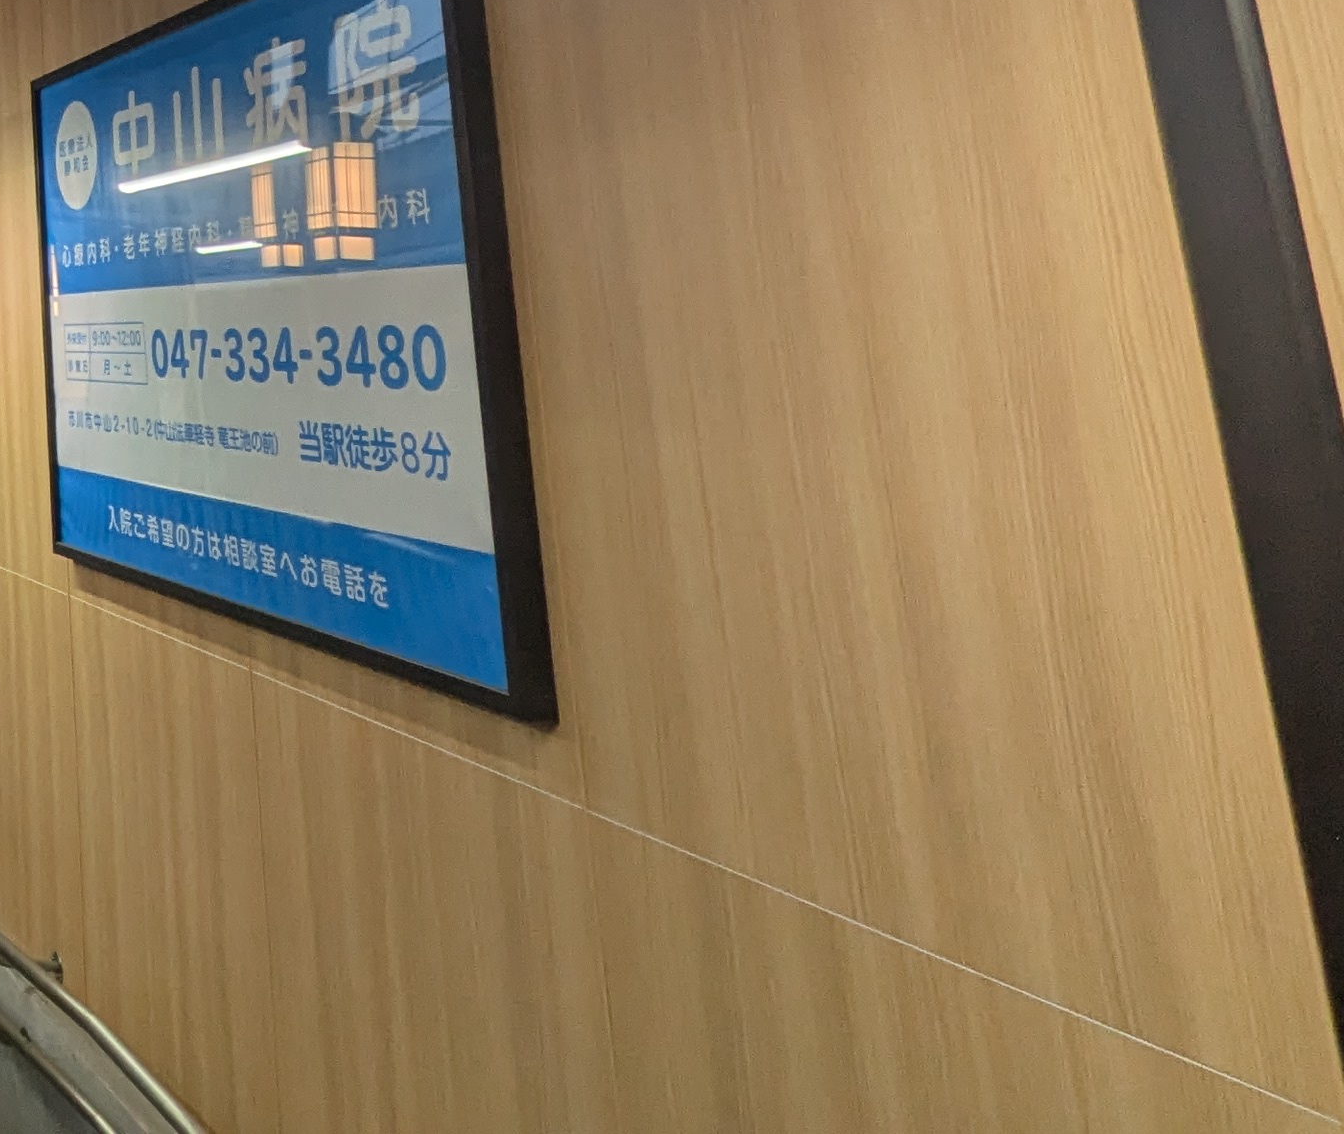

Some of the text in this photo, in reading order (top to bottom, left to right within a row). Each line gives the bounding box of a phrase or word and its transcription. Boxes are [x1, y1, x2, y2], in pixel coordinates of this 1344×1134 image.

[151, 324, 447, 391] 047-334-3480
[299, 420, 452, 482] 当駅徒歩8分
[108, 505, 390, 609] 入院ご希望の方は相談室へお電話を
